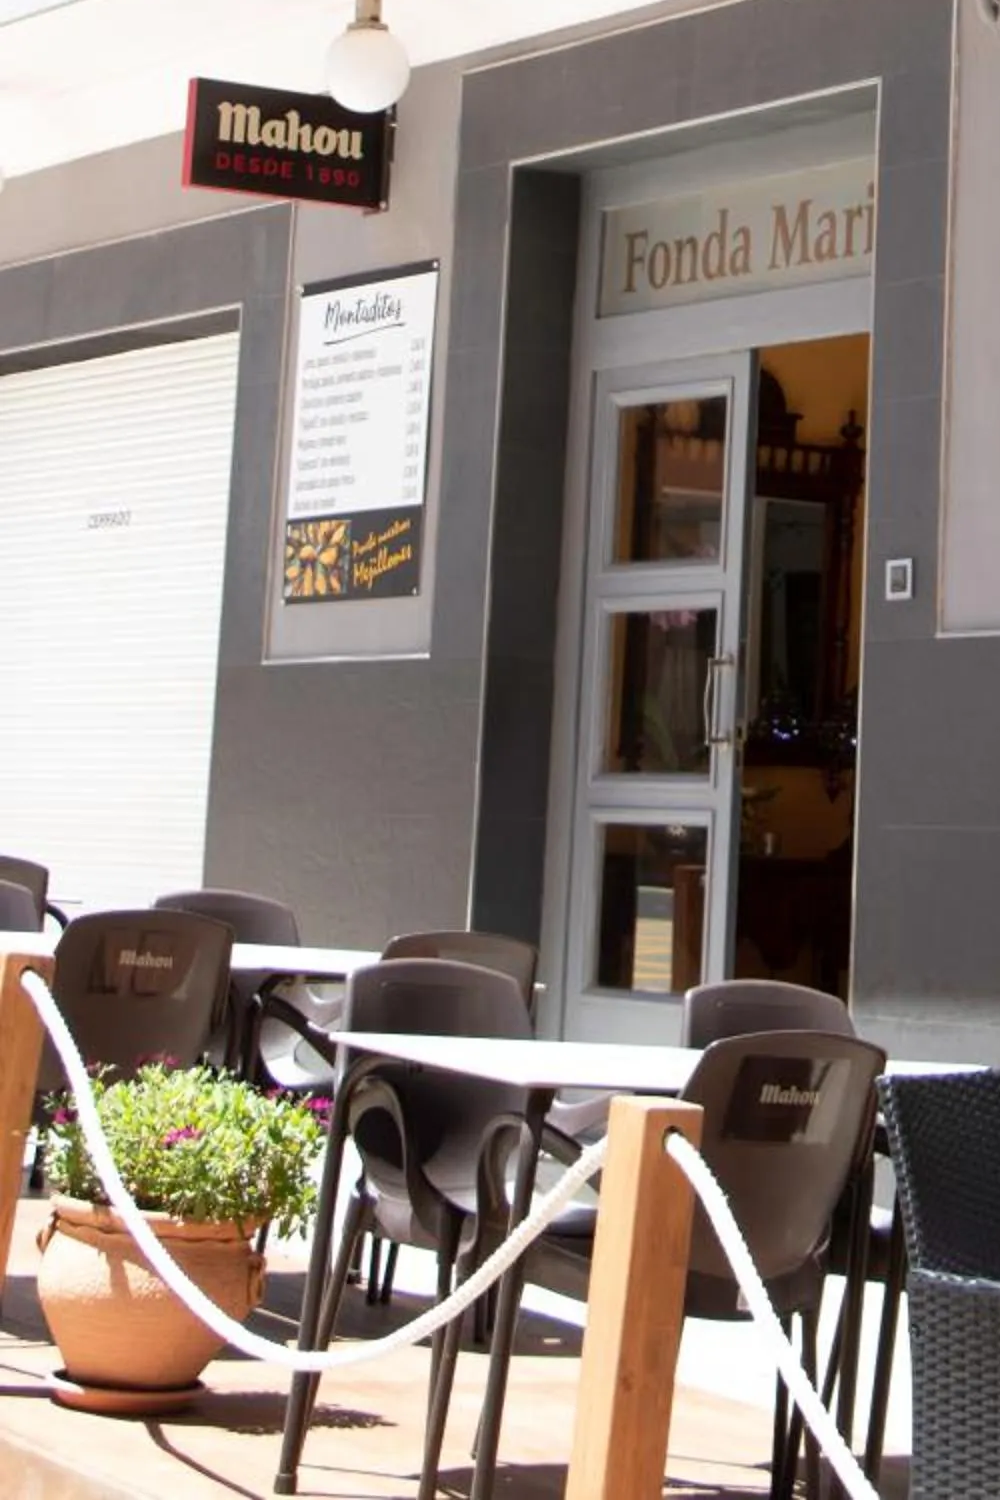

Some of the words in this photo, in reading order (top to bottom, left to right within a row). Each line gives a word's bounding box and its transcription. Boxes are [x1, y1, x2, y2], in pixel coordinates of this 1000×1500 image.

[217, 100, 364, 161] Mahou
[215, 151, 294, 180] DESDE
[623, 208, 753, 293] Fonda
[322, 291, 402, 332] Montaditos
[119, 949, 174, 969] Mahou
[759, 1083, 821, 1106] Mahou
